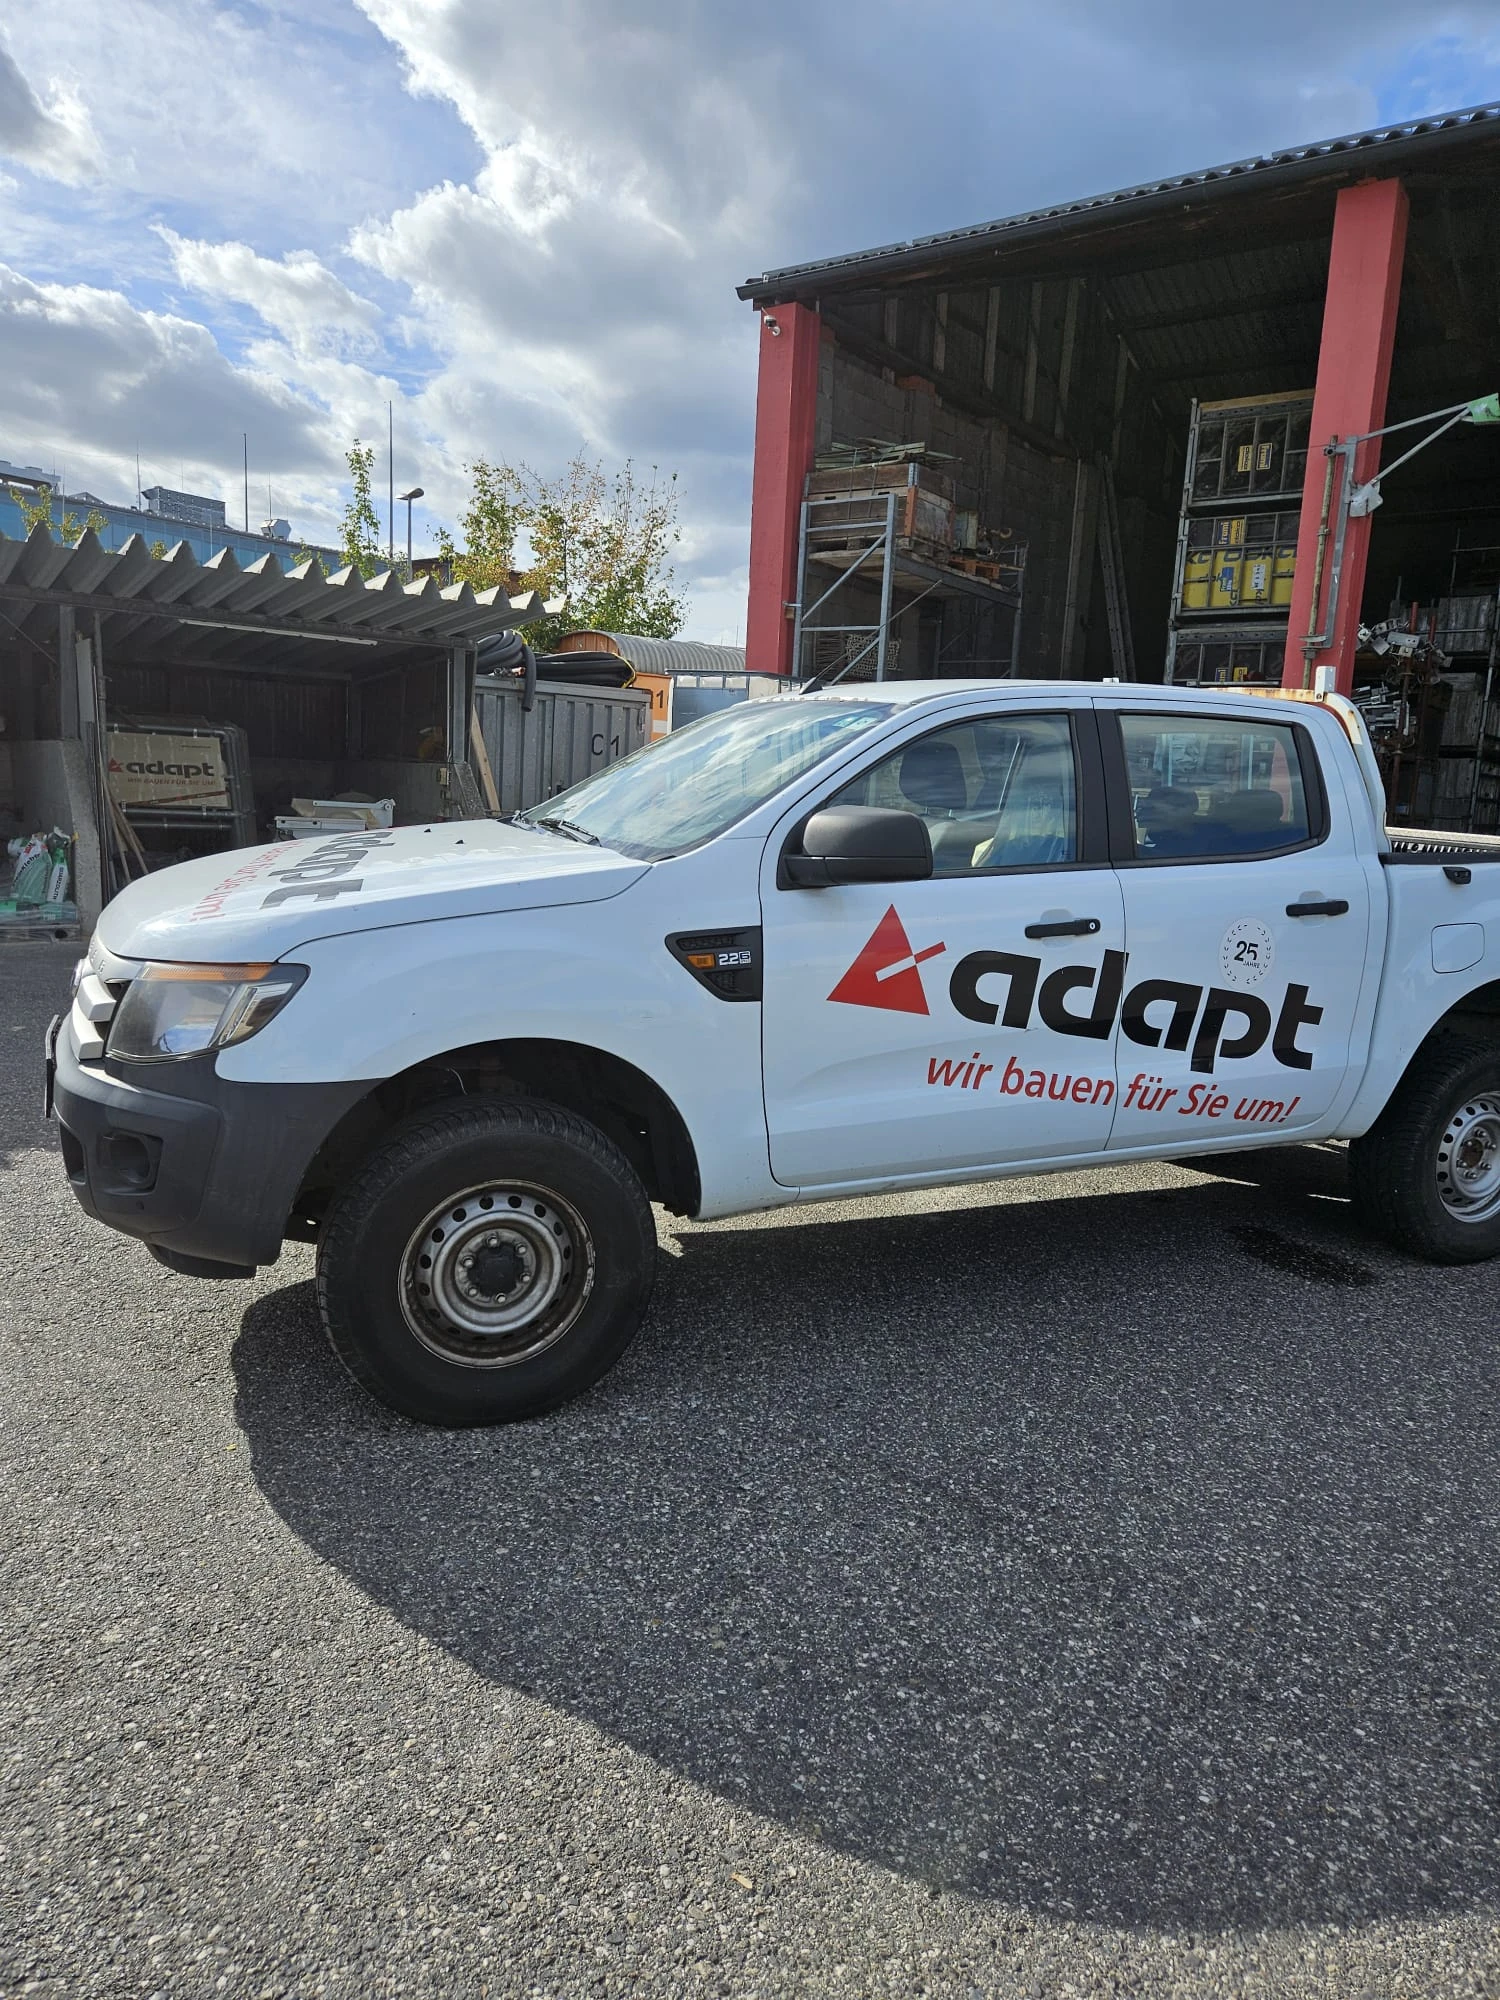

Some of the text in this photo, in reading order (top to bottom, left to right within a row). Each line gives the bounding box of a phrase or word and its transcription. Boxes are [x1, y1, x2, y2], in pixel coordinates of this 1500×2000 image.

[126, 760, 215, 779] adapt
[1234, 940, 1259, 961] 25
[1242, 960, 1261, 969] JAHRE
[949, 948, 1324, 1075] adapt
[927, 1052, 1302, 1123] wir bauen für Sie um!
